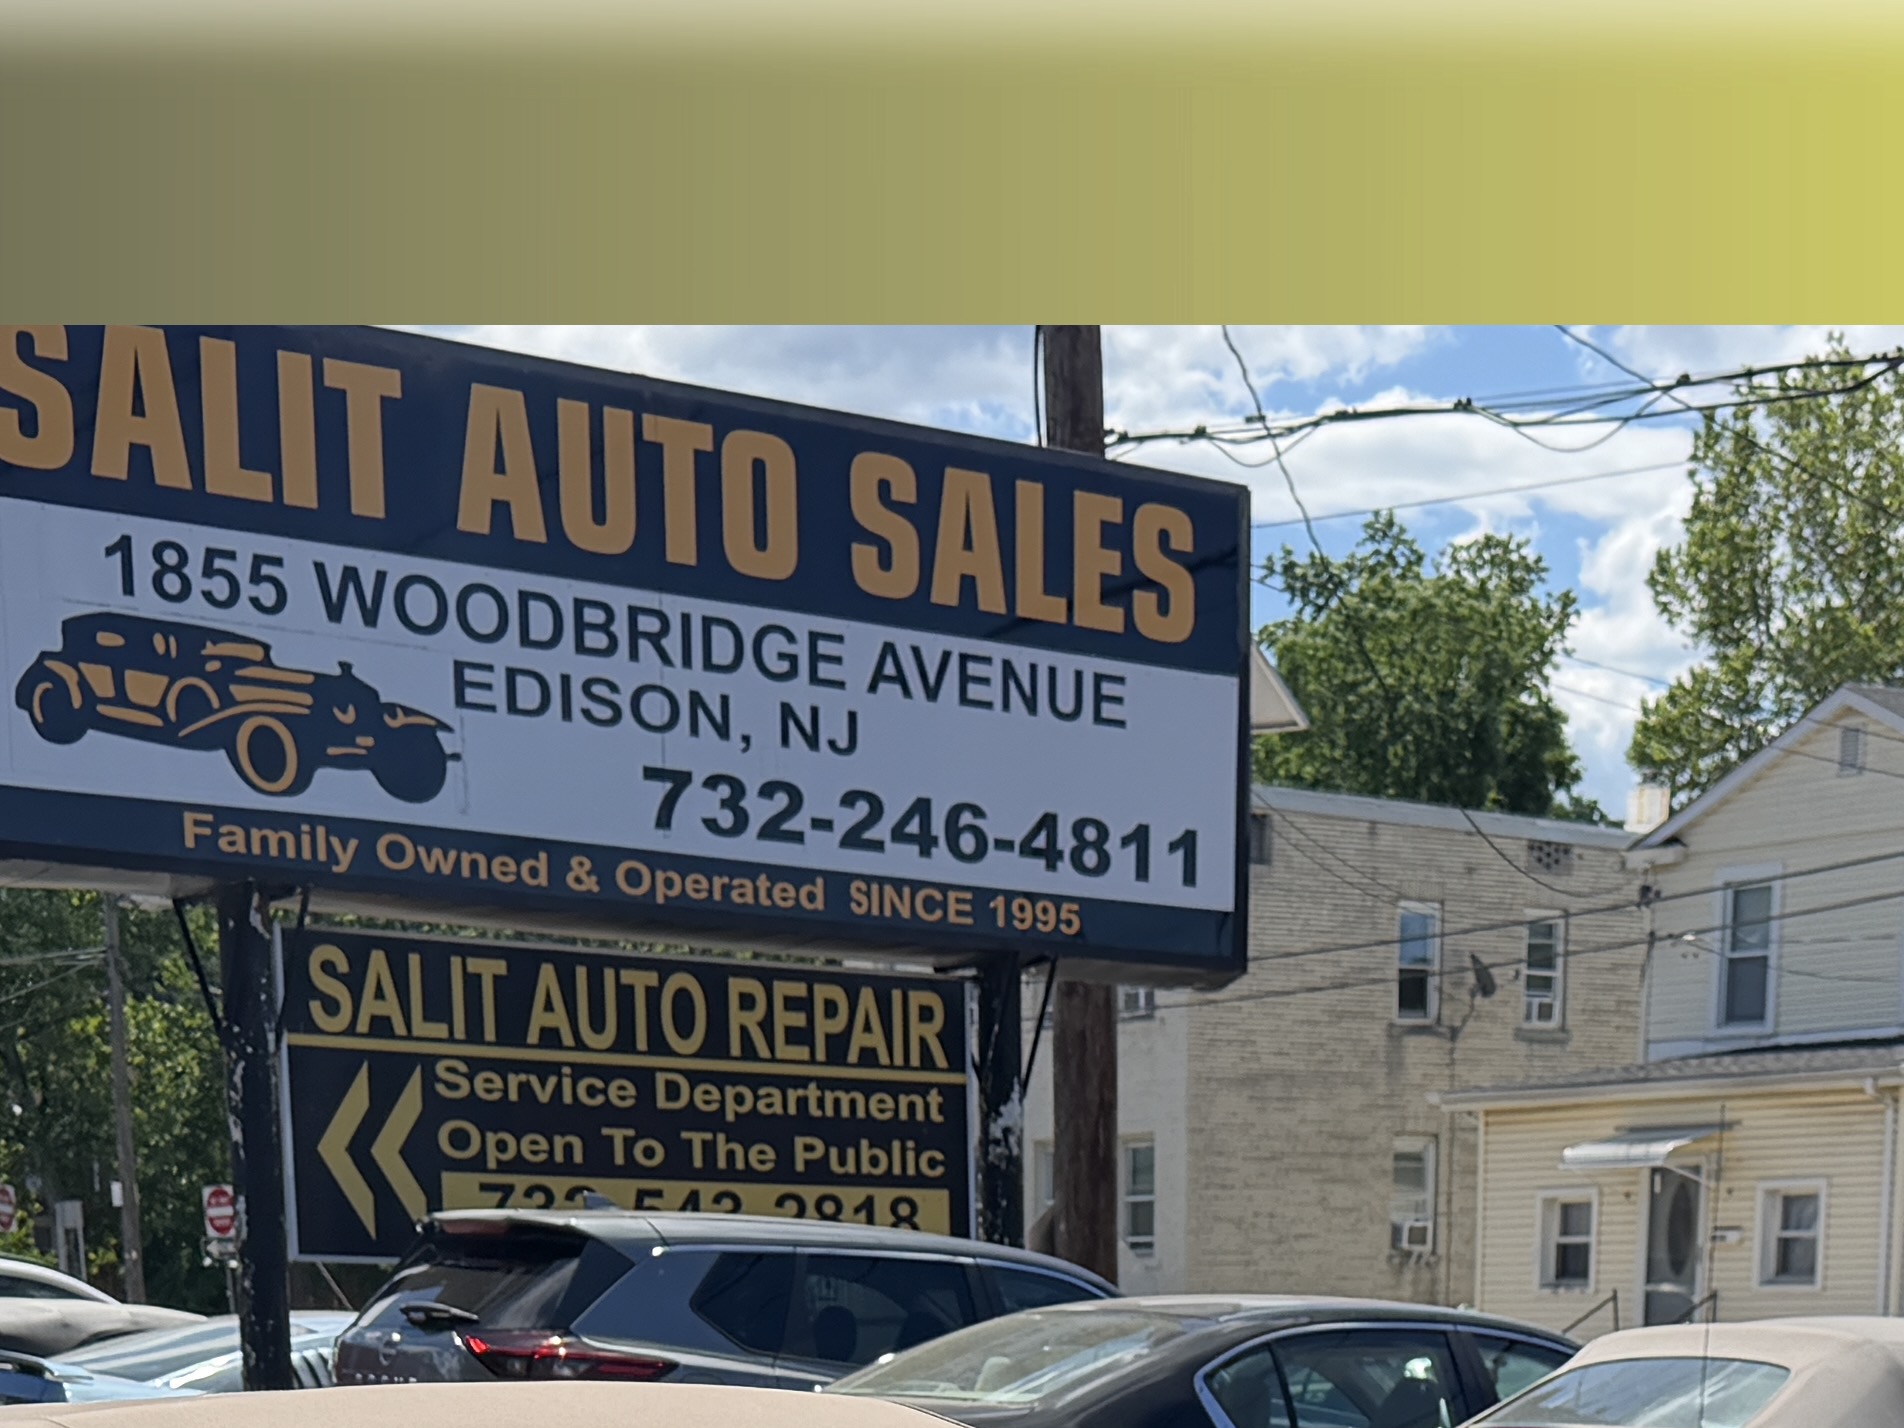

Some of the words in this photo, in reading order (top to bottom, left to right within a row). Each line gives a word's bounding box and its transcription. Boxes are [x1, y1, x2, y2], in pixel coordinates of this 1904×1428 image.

[456, 383, 798, 580] AUTO
[849, 451, 1196, 643] SALES
[104, 534, 288, 615] 1855
[313, 561, 846, 690] WOODBRIDGE
[867, 642, 1127, 729] AVENUE
[453, 660, 752, 755] EDISON,
[779, 701, 859, 757] NJ
[183, 811, 358, 872] Family
[376, 834, 549, 888] Owned
[565, 855, 600, 893] &
[615, 859, 825, 913] Operated
[849, 881, 974, 925] SINCE
[989, 896, 1081, 935] 1995
[642, 766, 1198, 888] 732-246-4811
[307, 944, 507, 1042] SALIT
[526, 962, 707, 1055] AUTO
[728, 976, 948, 1069] REPAIR
[434, 1059, 637, 1109] Service
[655, 1071, 944, 1124] Department
[438, 1119, 584, 1170] Open
[601, 1126, 666, 1168] To
[681, 1131, 776, 1172] The
[795, 1135, 946, 1178] Public
